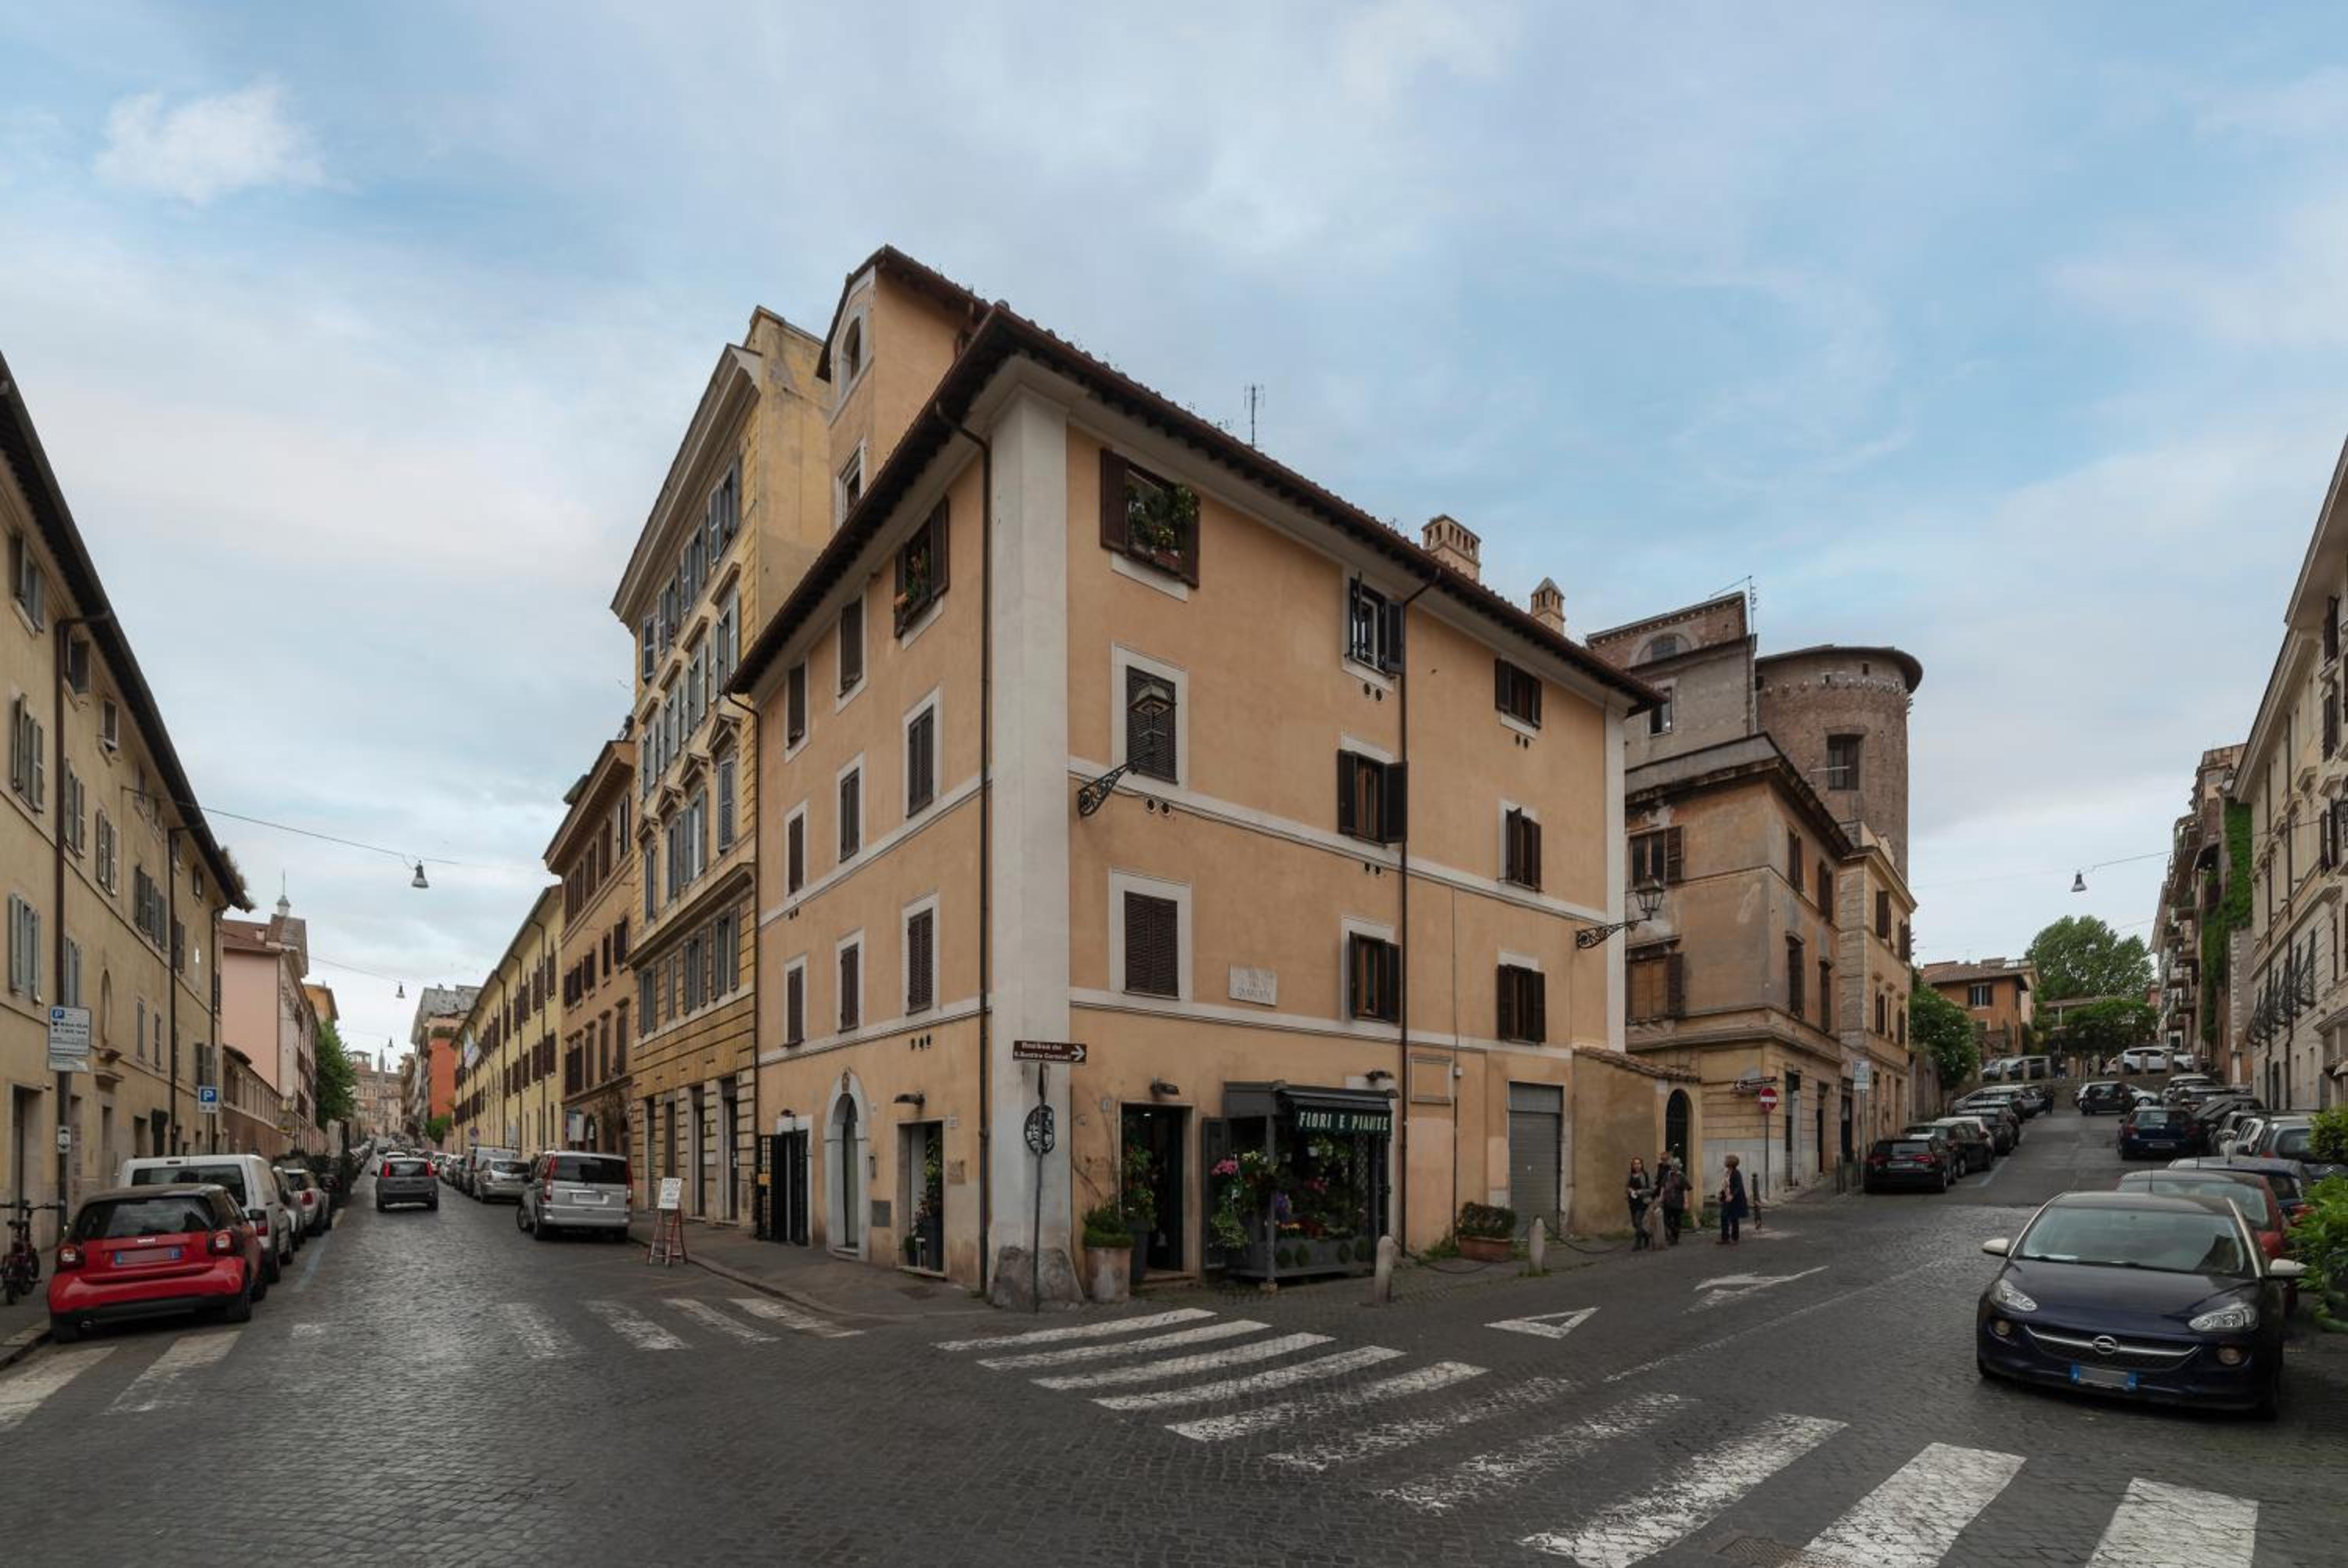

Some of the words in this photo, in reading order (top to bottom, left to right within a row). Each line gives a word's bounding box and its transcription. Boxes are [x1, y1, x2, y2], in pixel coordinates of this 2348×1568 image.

[203, 1090, 214, 1101] P
[1299, 1112, 1332, 1128] FIORI
[1339, 1113, 1345, 1128] E
[1352, 1115, 1389, 1131] PIANTE
